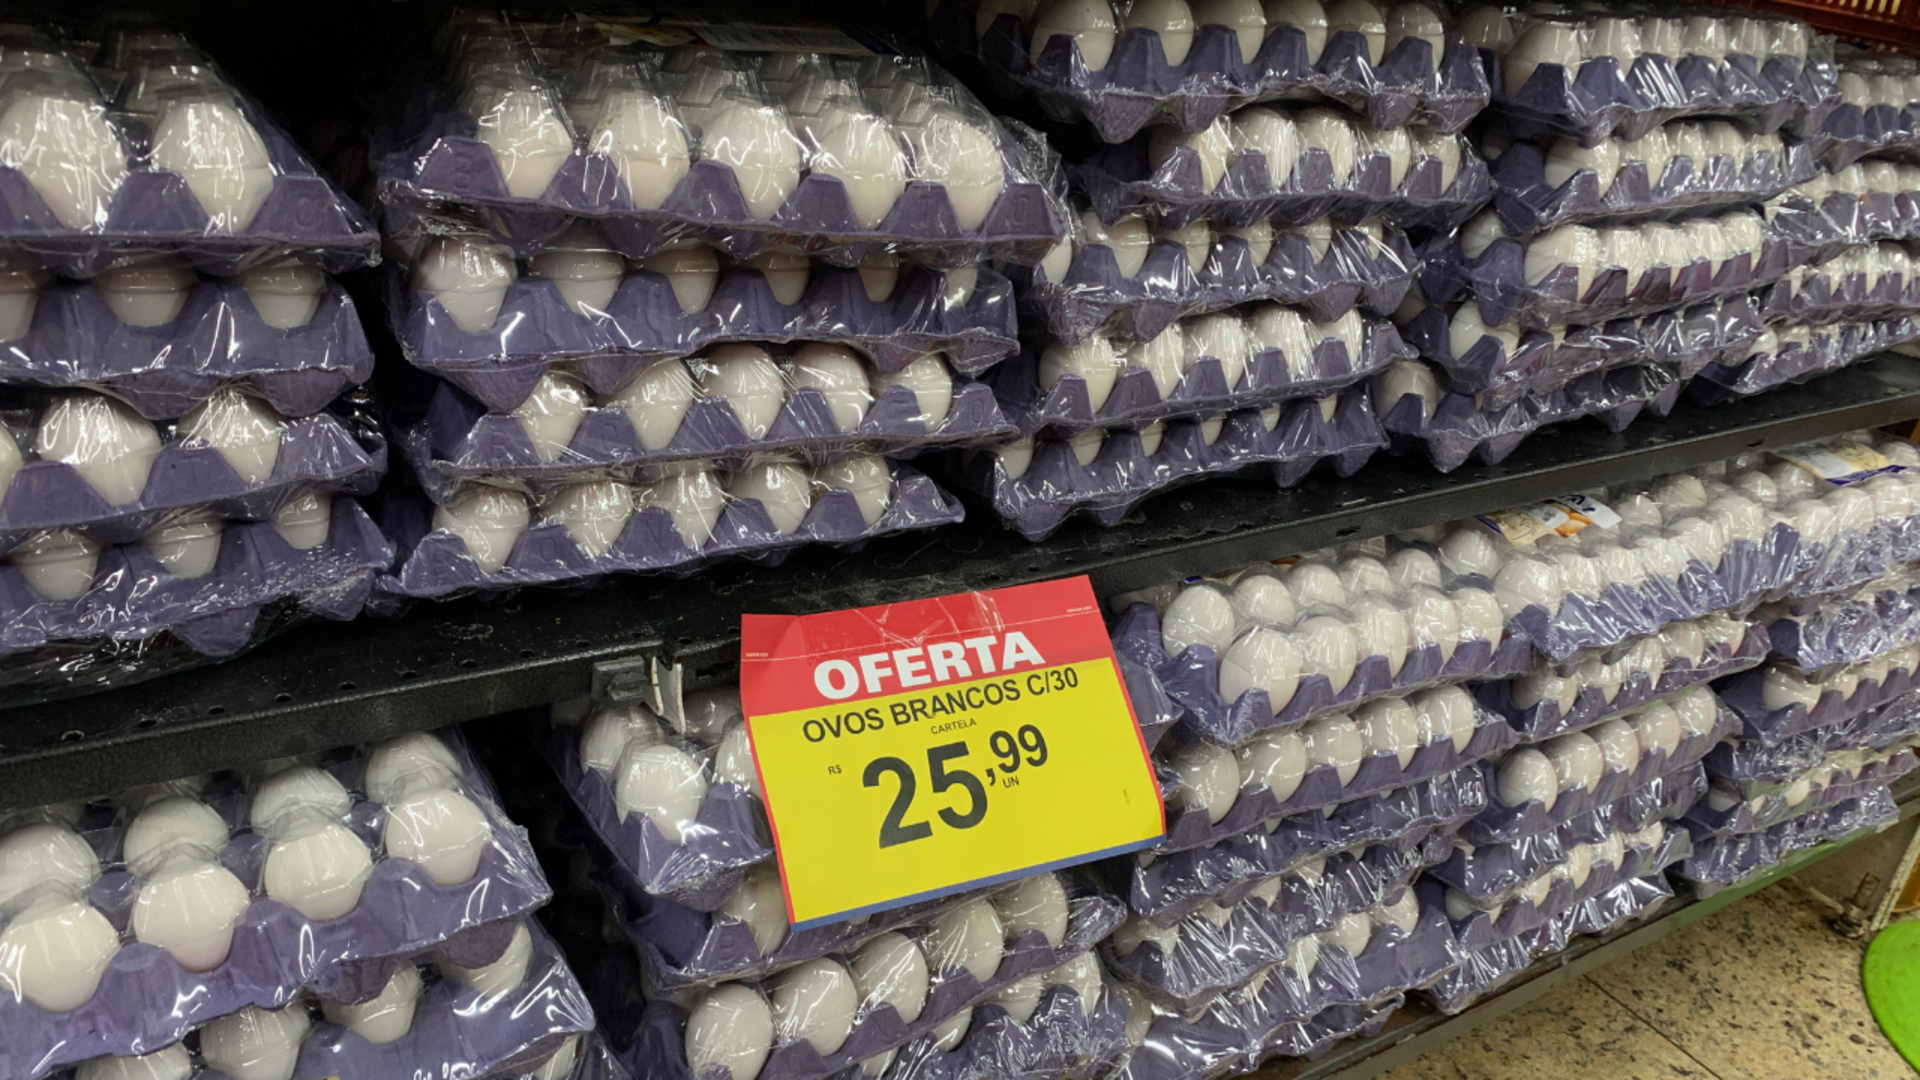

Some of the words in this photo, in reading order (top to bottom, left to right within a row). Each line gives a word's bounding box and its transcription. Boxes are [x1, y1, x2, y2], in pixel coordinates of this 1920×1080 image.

[814, 630, 1046, 700] OFERTA
[802, 707, 885, 743] OVOS
[888, 678, 1021, 727] BRANCOS
[1026, 666, 1079, 698] C/30
[930, 717, 977, 735] CARTELA
[827, 764, 842, 775] R$
[1002, 775, 1020, 789] UN
